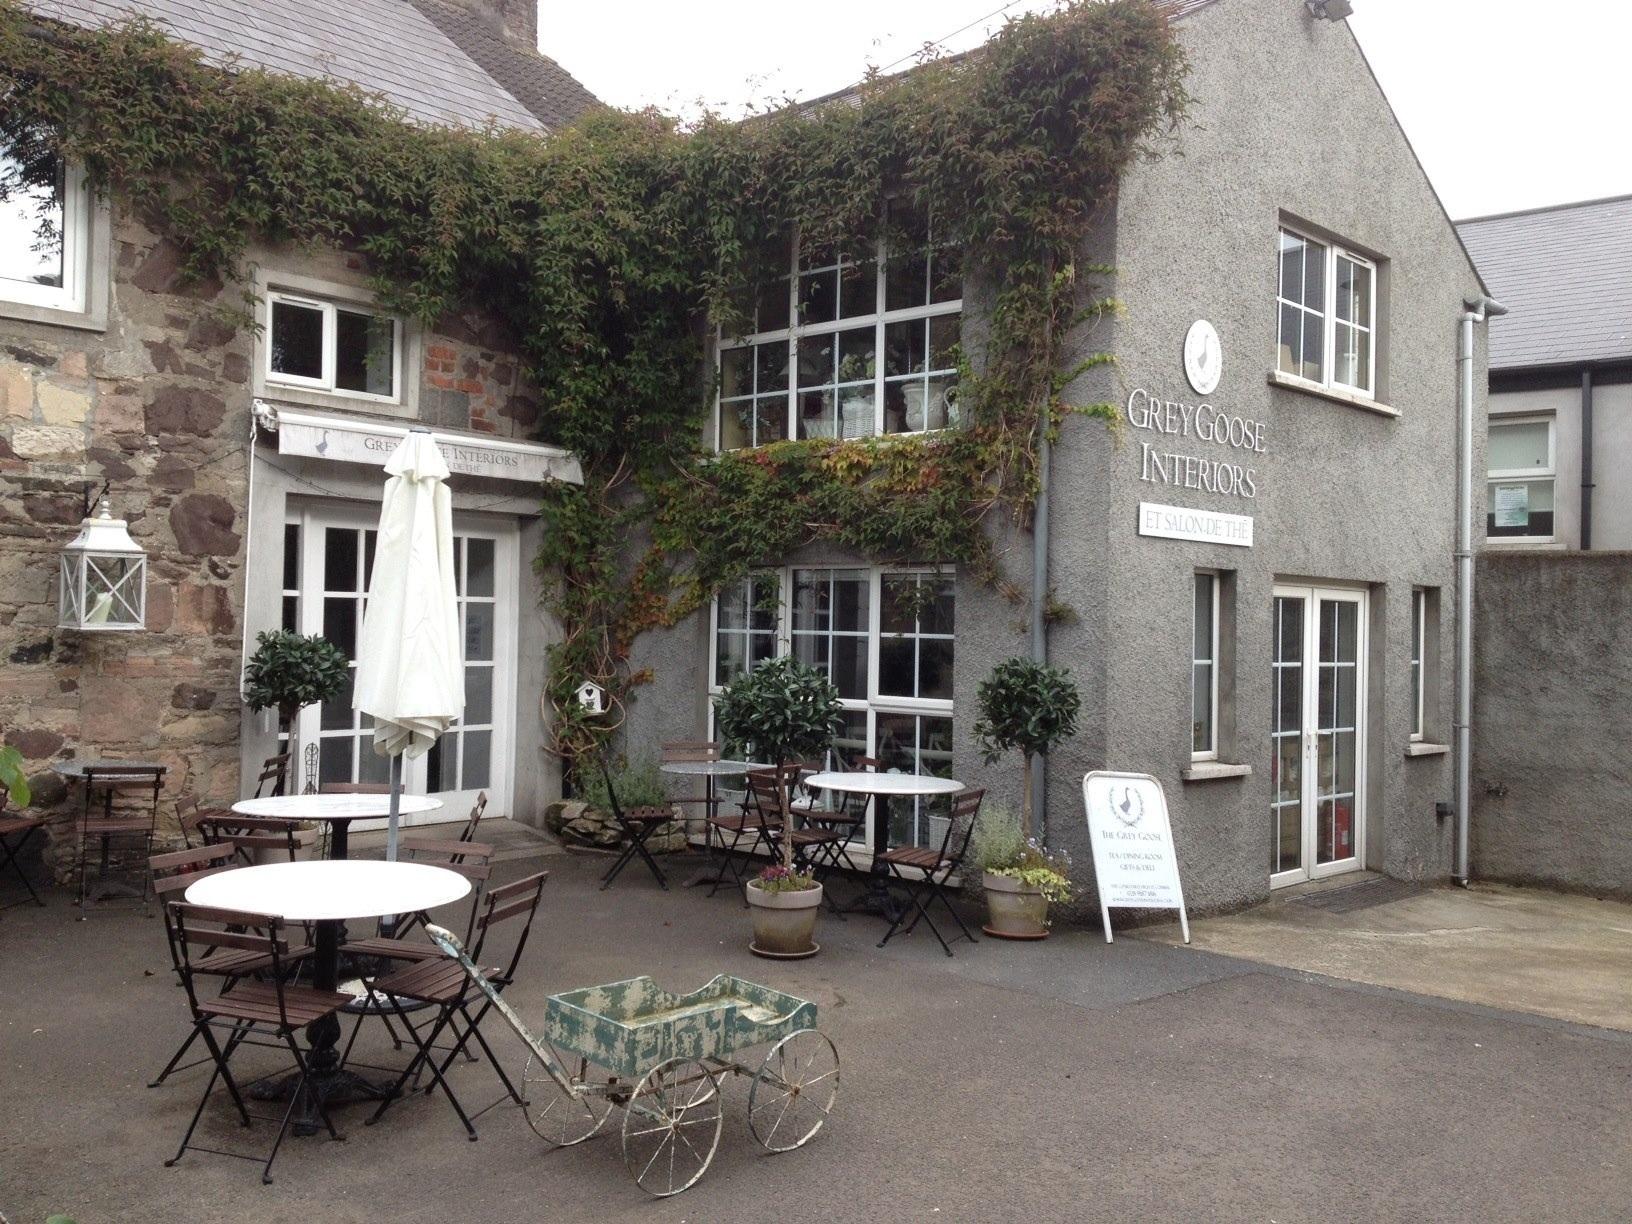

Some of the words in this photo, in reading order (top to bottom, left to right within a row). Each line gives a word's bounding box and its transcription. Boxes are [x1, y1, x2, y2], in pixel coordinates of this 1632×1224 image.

[1128, 388, 1193, 436] GREY
[1195, 404, 1266, 452] GOOSE
[454, 448, 518, 467] INTERIORS
[1139, 442, 1256, 497] INTERIORS
[1146, 510, 1162, 529] ET
[1206, 518, 1222, 536] DE
[1102, 830, 1114, 840] THE
